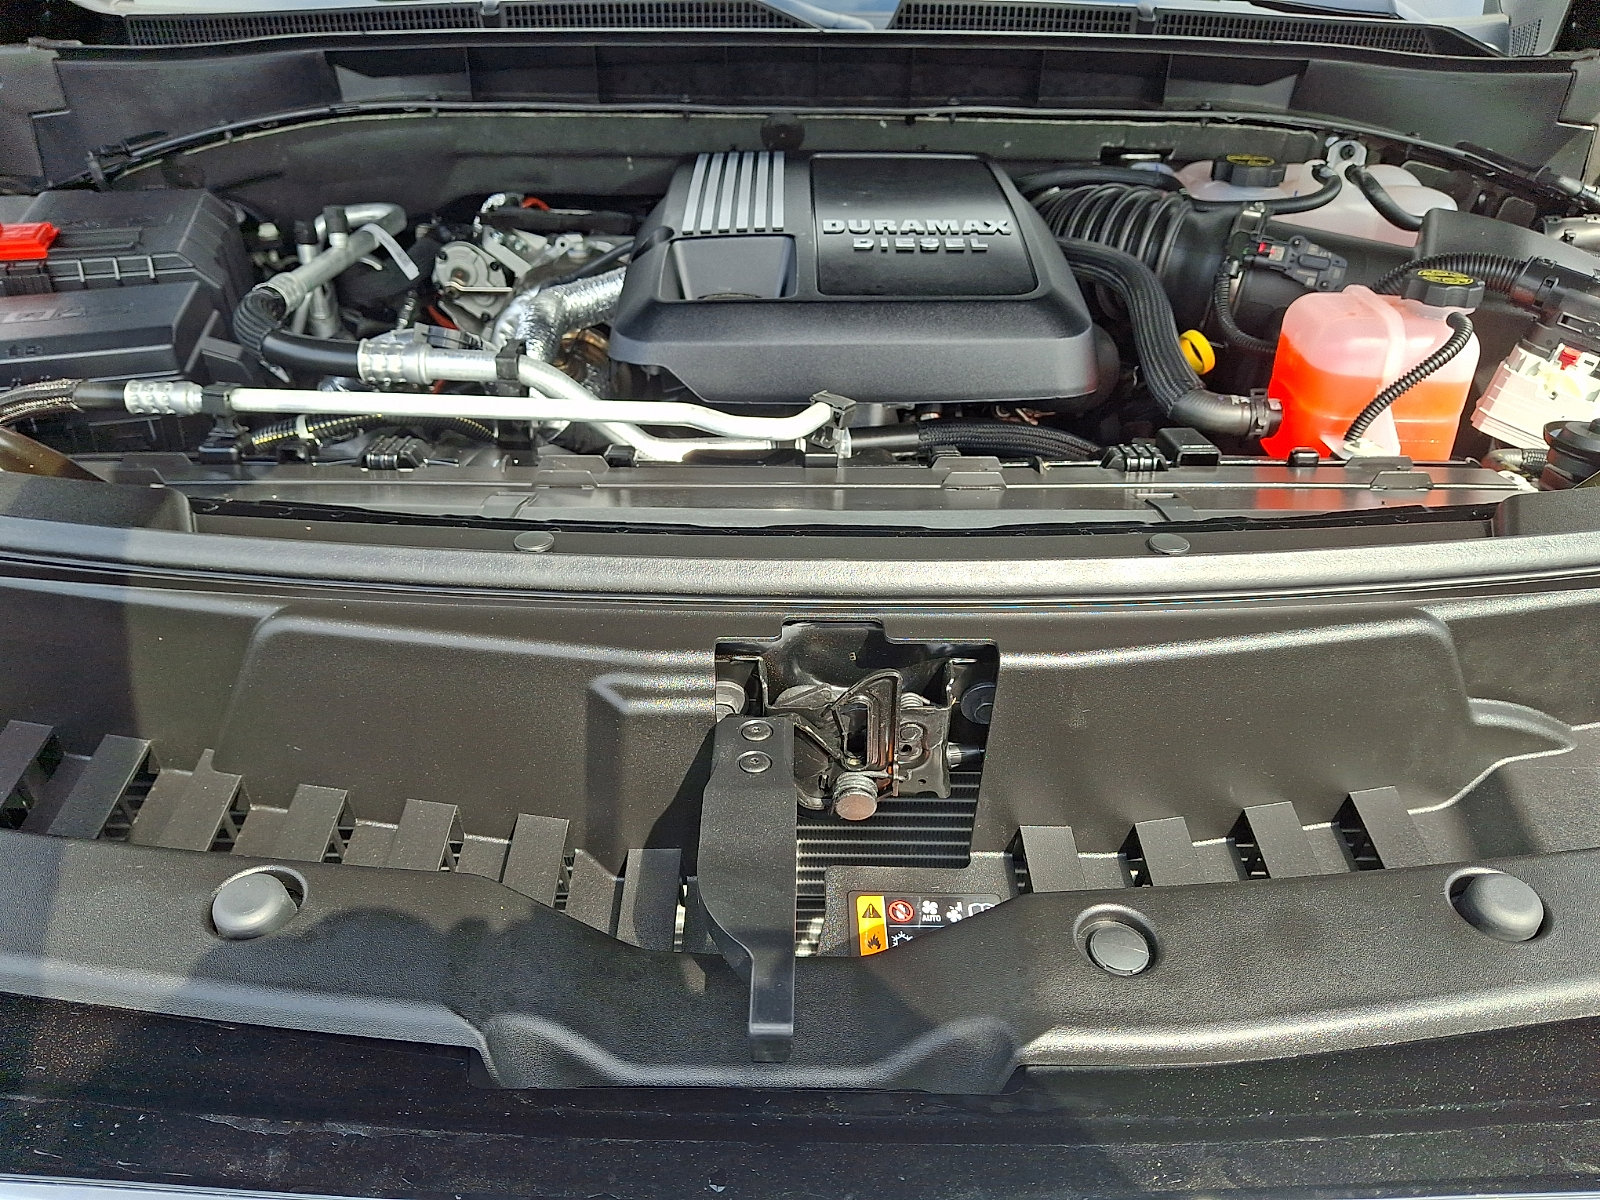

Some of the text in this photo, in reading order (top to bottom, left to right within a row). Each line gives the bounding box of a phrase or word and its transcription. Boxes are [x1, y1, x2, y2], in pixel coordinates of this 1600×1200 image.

[823, 219, 1012, 235] DURAMAX
[853, 238, 989, 252] DIESEL
[922, 914, 941, 922] AUTO
